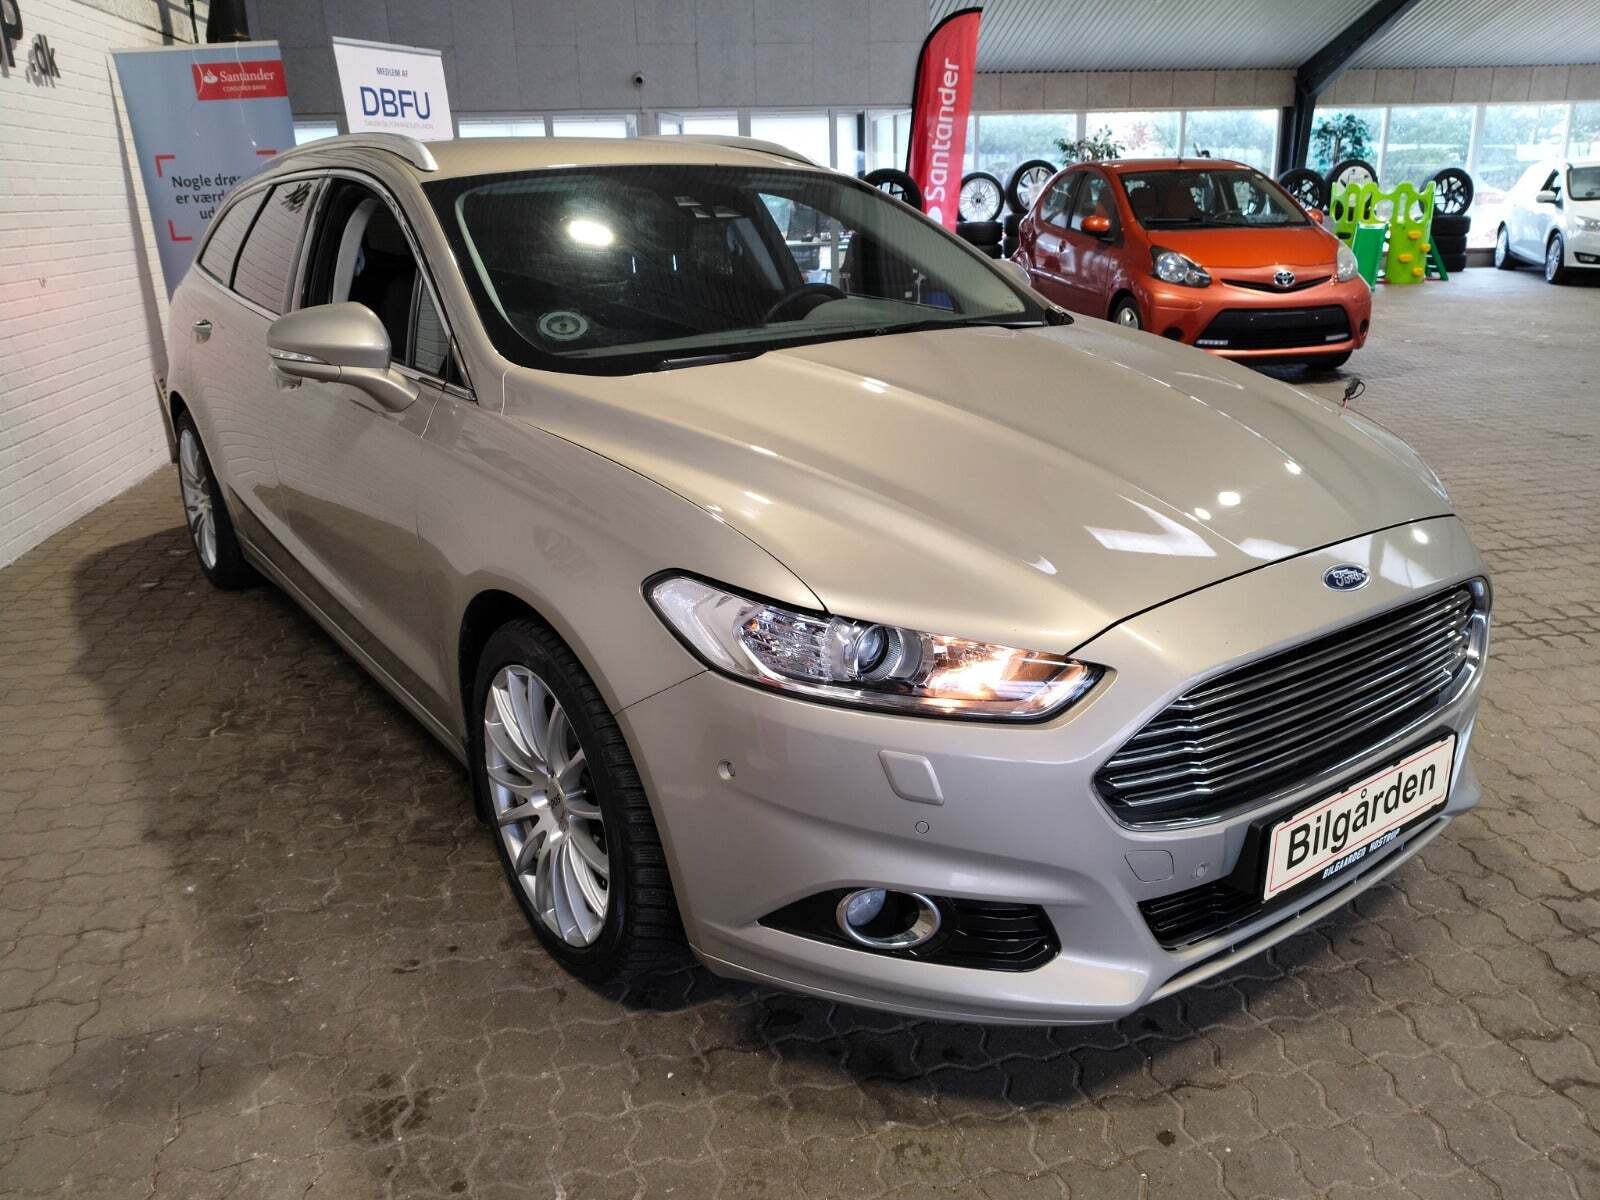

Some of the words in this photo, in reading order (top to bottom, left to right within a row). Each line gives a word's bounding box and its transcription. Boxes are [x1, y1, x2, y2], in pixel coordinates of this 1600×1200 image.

[220, 67, 275, 82] Santander
[376, 67, 401, 77] MEDLEM
[360, 86, 431, 120] DBFU
[924, 57, 960, 202] Santander
[171, 174, 212, 191] Nogle
[214, 173, 241, 187] drø
[175, 194, 190, 204] er
[192, 190, 225, 204] værd
[1332, 569, 1365, 587] Ford
[1286, 763, 1436, 871] Bilgården
